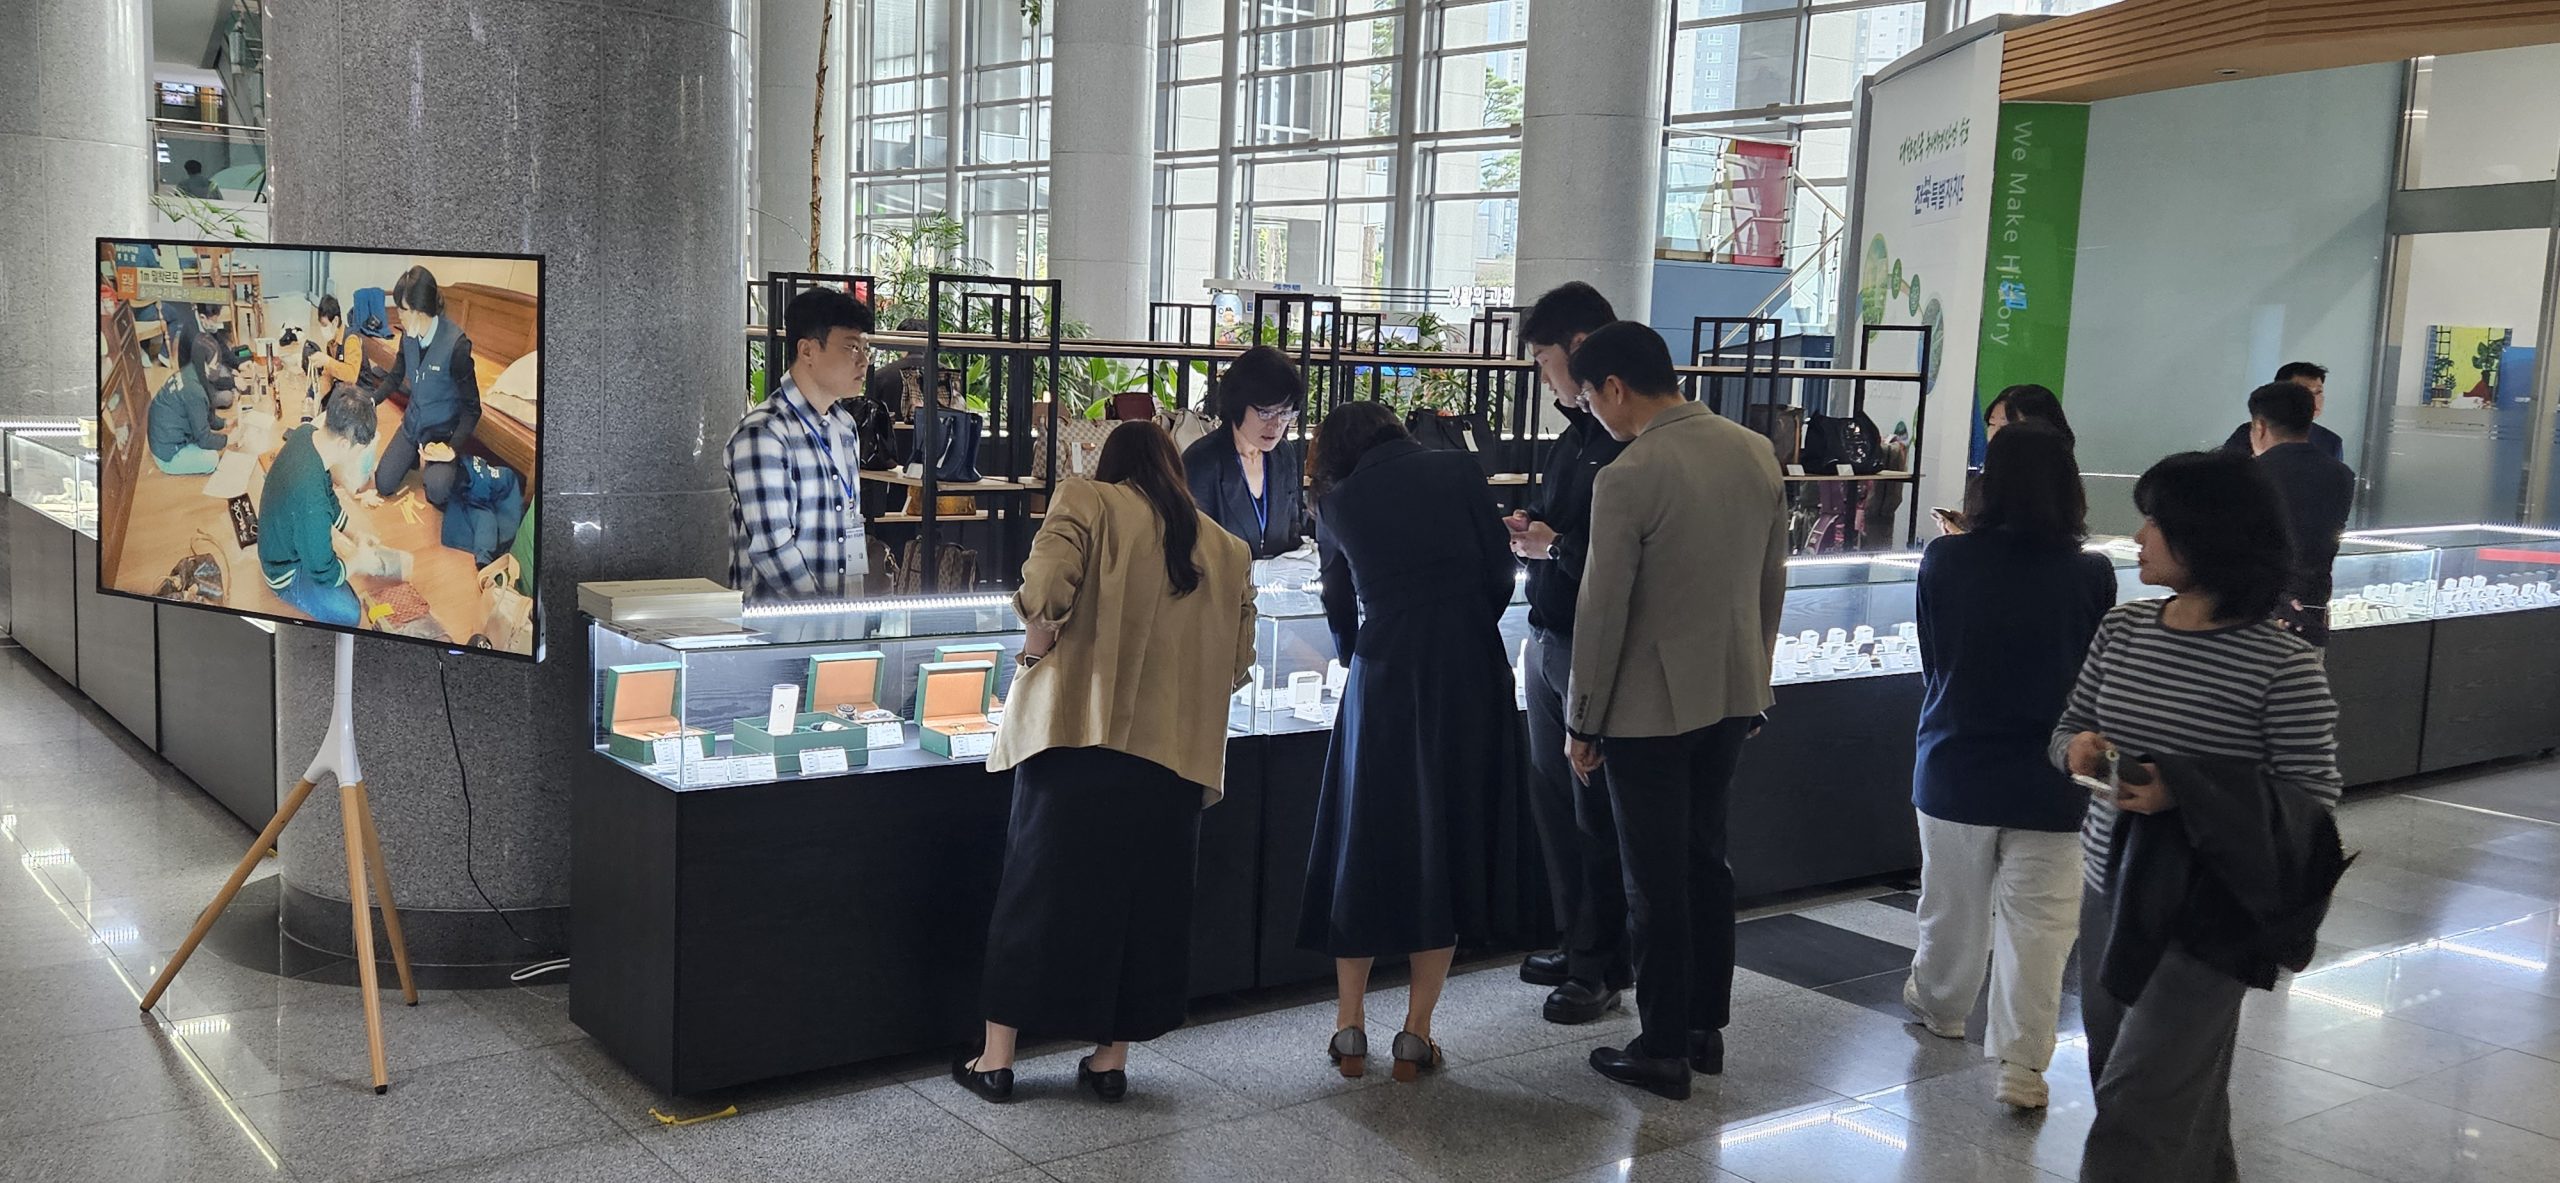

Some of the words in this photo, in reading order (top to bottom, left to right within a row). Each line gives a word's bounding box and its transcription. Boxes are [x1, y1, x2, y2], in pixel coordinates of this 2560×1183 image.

[1899, 130, 1924, 166] 대한민국
[2011, 120, 2033, 161] We
[2003, 172, 2029, 243] Make
